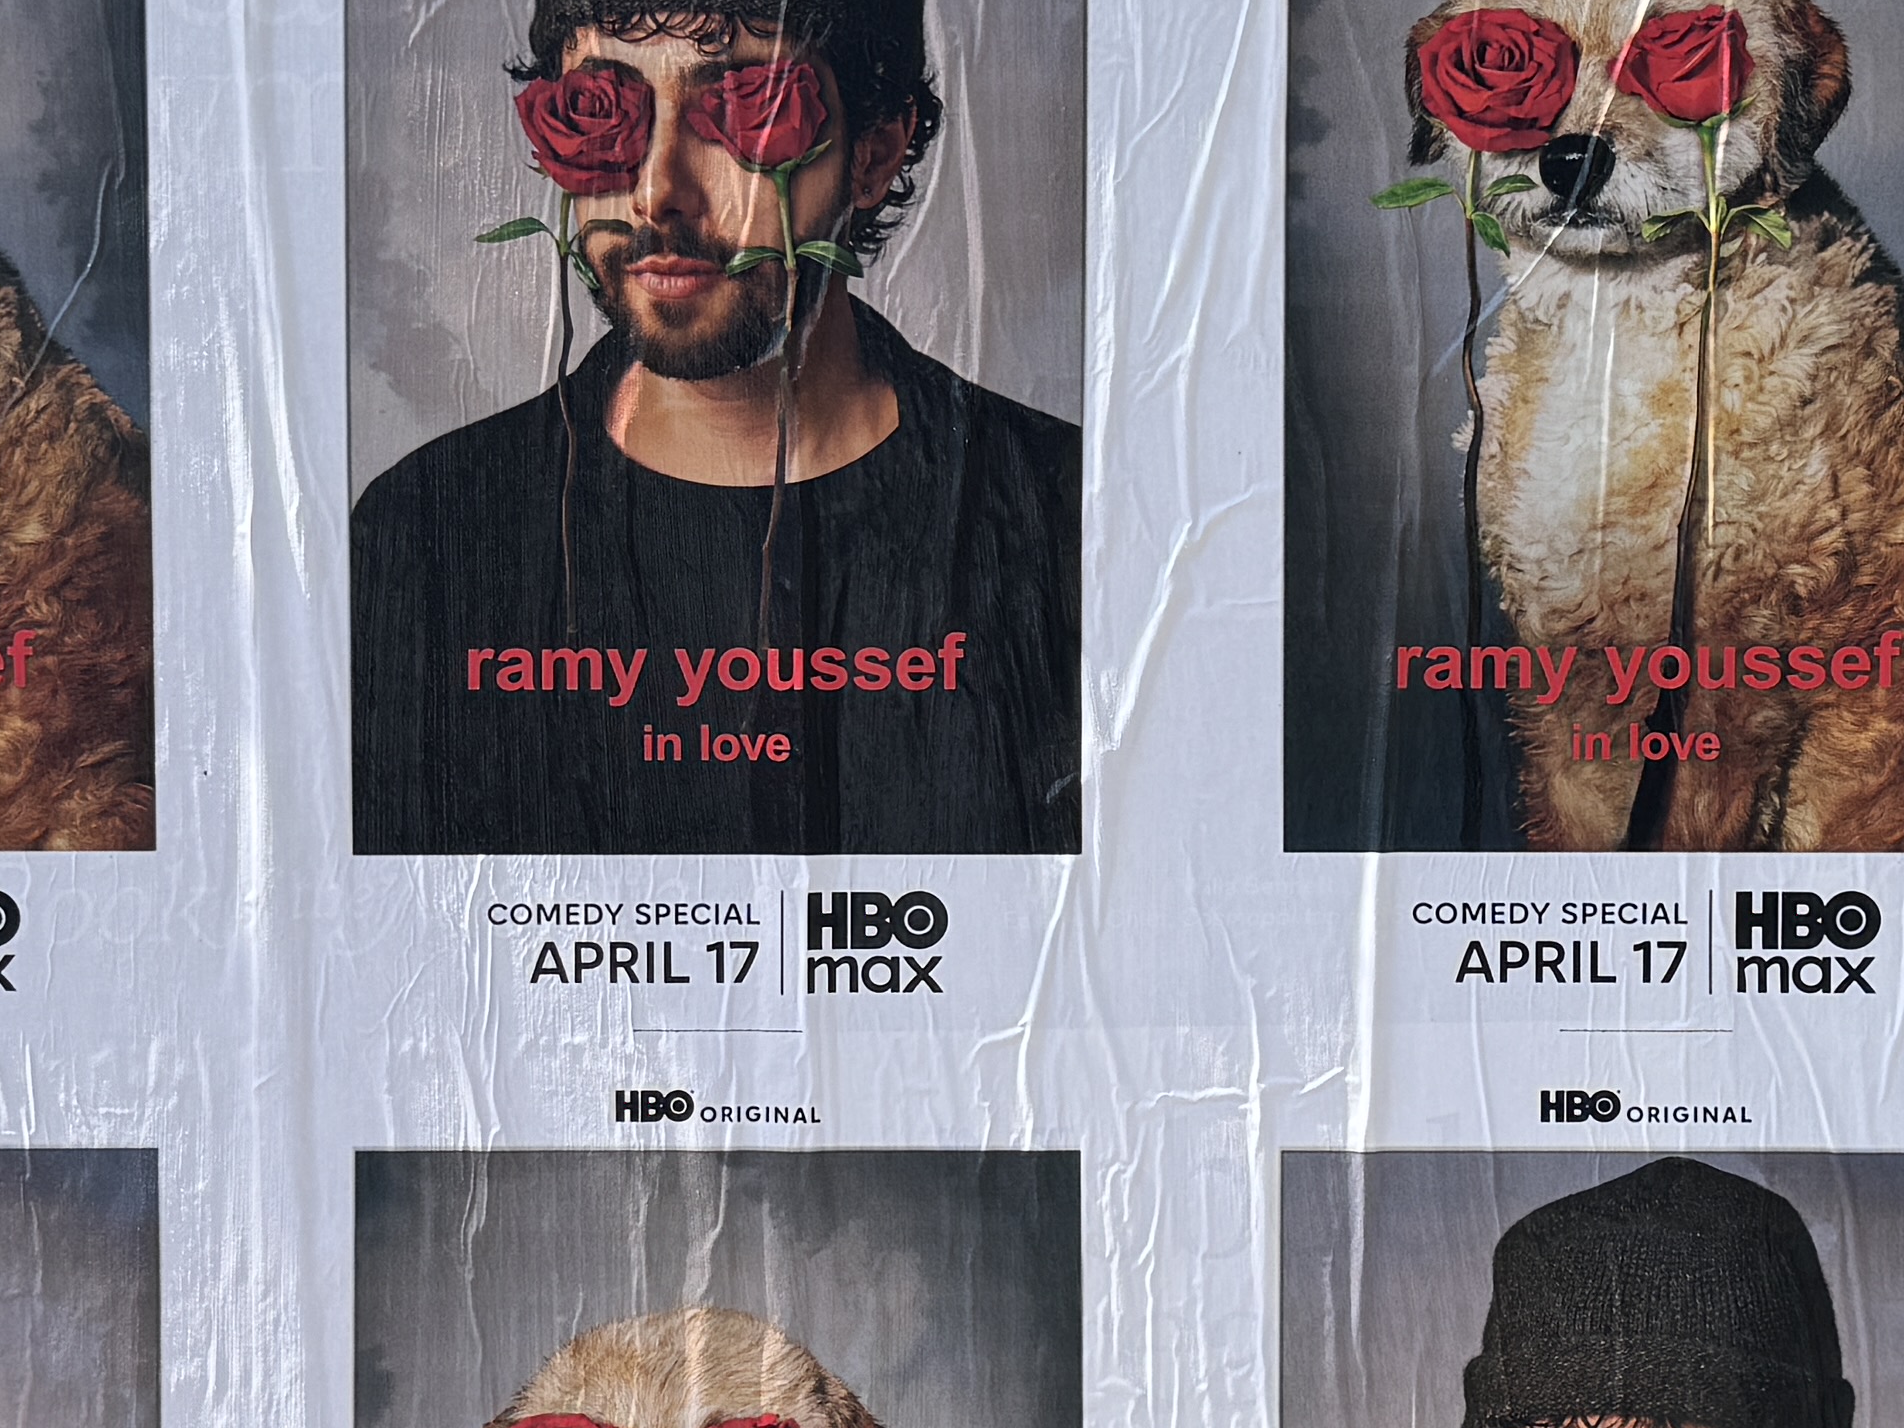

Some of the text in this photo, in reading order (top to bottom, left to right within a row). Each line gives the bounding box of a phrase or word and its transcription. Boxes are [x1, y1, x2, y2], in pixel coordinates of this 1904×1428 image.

[467, 632, 966, 707] ramy youssef
[1396, 631, 1903, 705] ramy youssef
[643, 724, 791, 762] in love
[1572, 723, 1721, 762] in love
[488, 902, 761, 926] COMEDY SPECIAL
[807, 890, 947, 950] HBO
[1412, 902, 1688, 926] COMEDY SPECIAL
[1736, 890, 1882, 950] HBO
[530, 941, 760, 984] APRIL 17
[806, 955, 943, 994] max
[1455, 941, 1688, 984] APRIL 17
[1737, 955, 1876, 995] max
[615, 1090, 821, 1124] HBO ORIGINAL
[1540, 1089, 1752, 1124] HBO ORIGINAL
